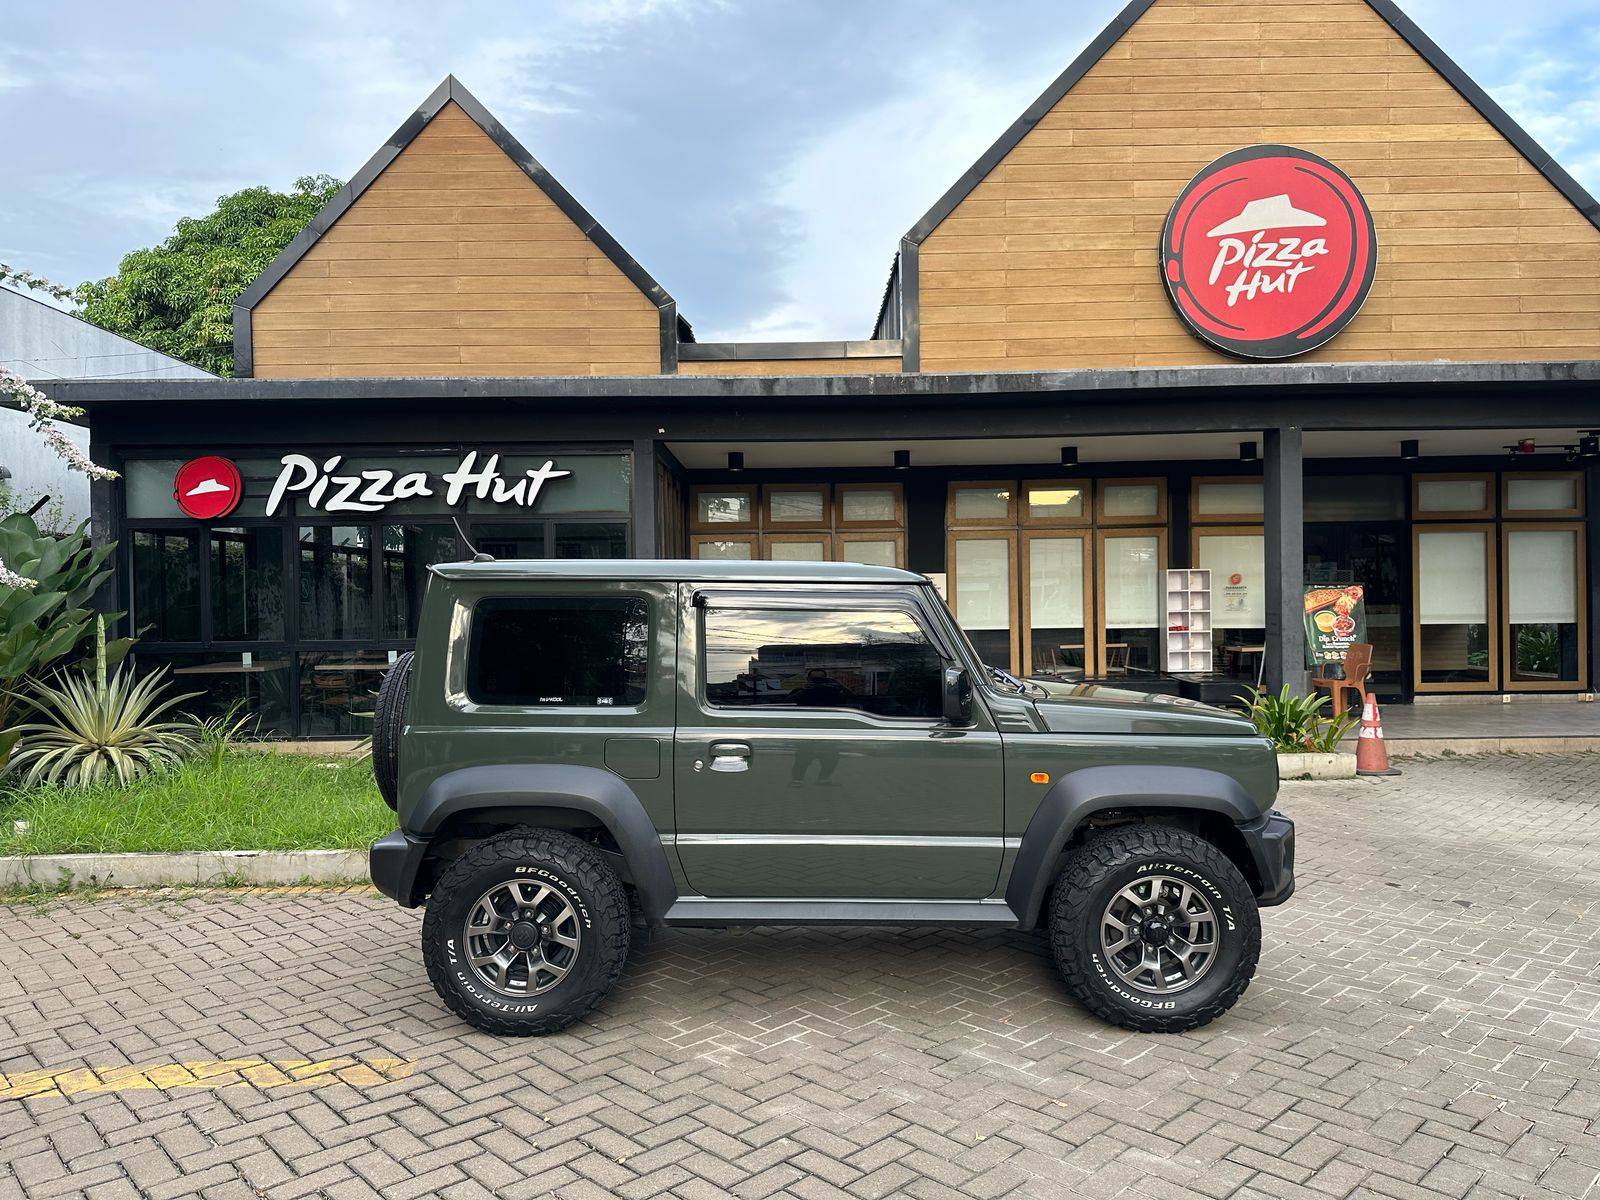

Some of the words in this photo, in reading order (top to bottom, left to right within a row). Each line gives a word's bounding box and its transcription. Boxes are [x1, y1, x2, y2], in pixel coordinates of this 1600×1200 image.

[1208, 230, 1329, 285] Pizza
[1225, 261, 1315, 307] Hut
[265, 453, 433, 517] Pizza
[442, 450, 571, 507] Hut
[514, 866, 592, 929] BFGoodrich
[1136, 863, 1222, 900] All-Terrain
[1222, 905, 1236, 931] T/A
[446, 939, 458, 965] T/A
[456, 971, 539, 1014] All-Terrain
[1091, 953, 1176, 1010] BFGoodrich
